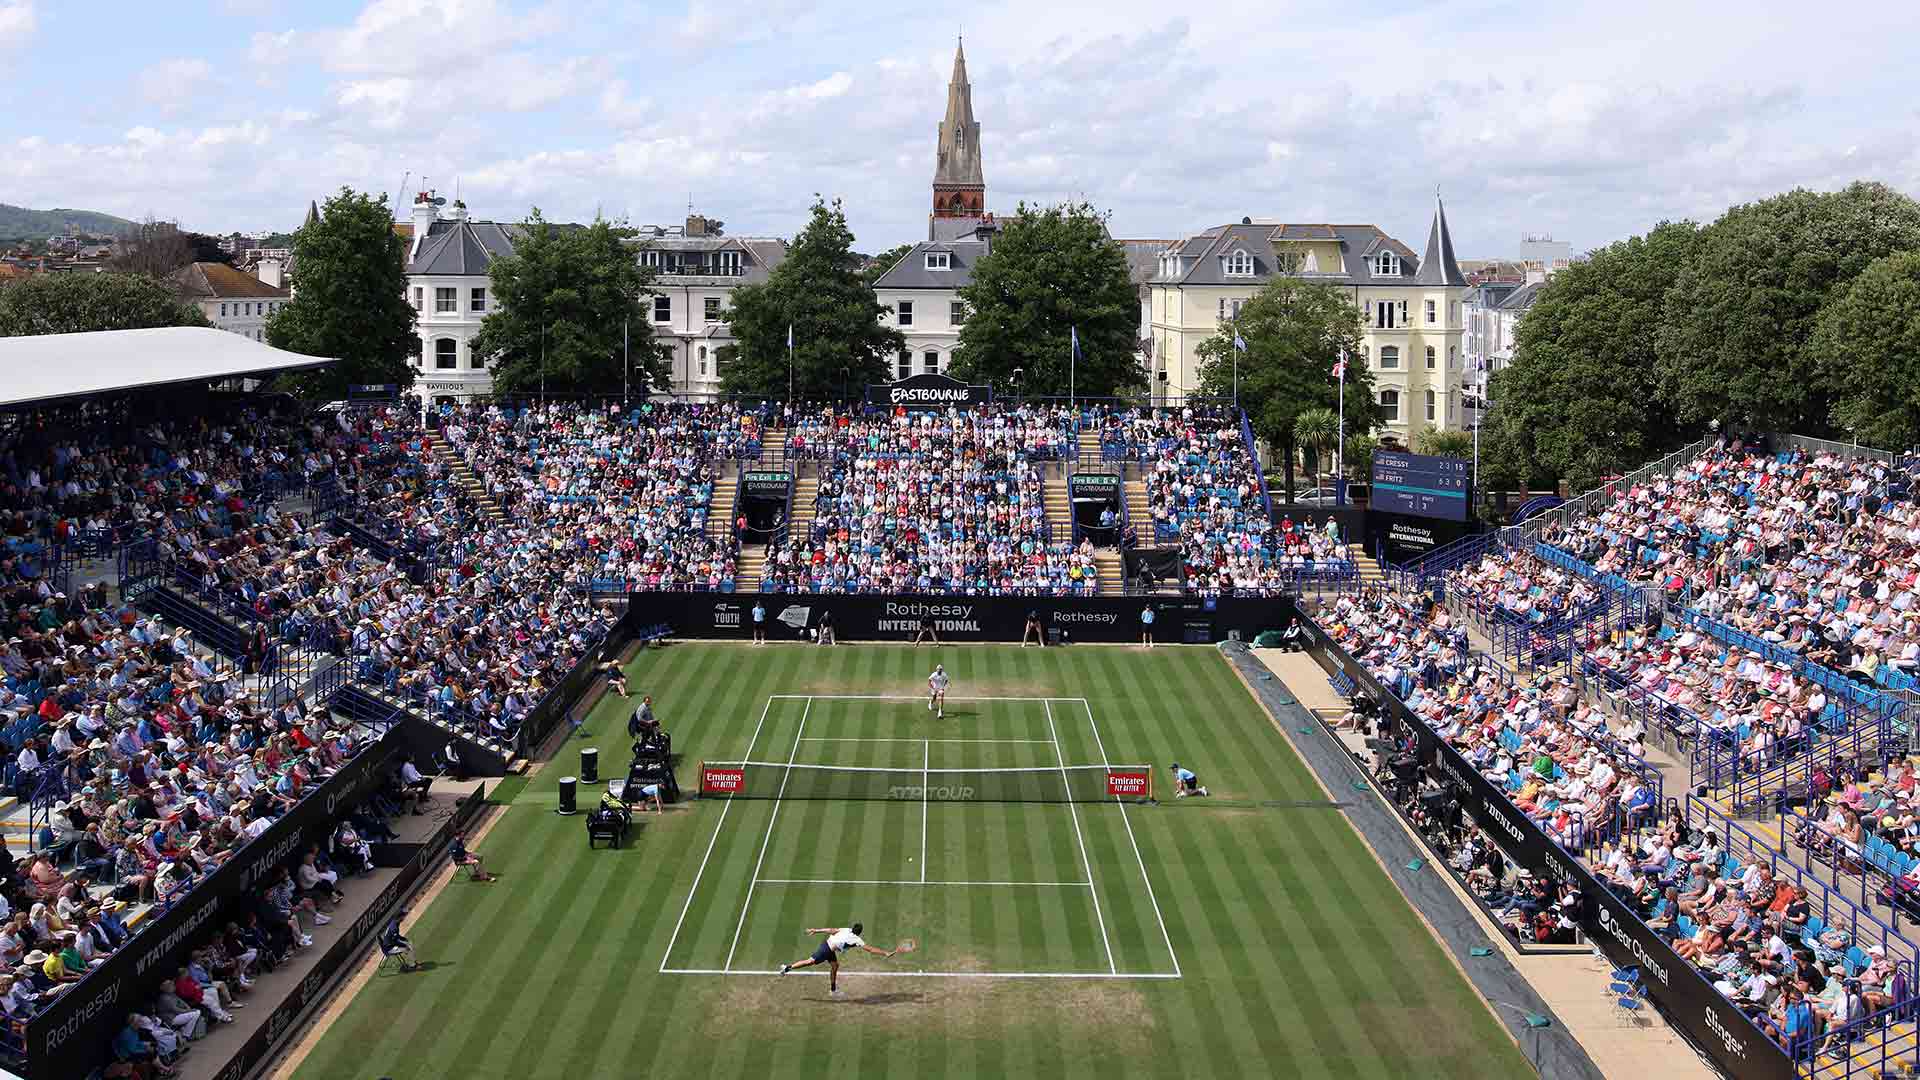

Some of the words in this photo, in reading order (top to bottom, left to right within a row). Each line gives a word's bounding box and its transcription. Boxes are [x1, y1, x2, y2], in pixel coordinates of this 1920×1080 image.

[890, 388, 969, 402] EASTBOURNE
[1385, 460, 1409, 468] CRESSY
[1455, 463, 1464, 471] 15
[1385, 475, 1403, 483] FRITZ
[1456, 479, 1461, 487] 0
[1392, 523, 1431, 537] Rothesay
[1389, 532, 1435, 544] INTERNATIONAL
[886, 602, 973, 619] Rothesay
[714, 612, 740, 624] YOUTH
[1053, 612, 1118, 625] Rothesay
[706, 772, 742, 781] Emirates
[1109, 776, 1145, 785] Emirates
[888, 785, 923, 800] ATP
[927, 786, 975, 800] TOUR
[1488, 803, 1525, 843] DUNLOP
[136, 895, 218, 977] WTATENNIS.COM
[1610, 917, 1632, 950] Clear
[1632, 939, 1669, 987] Channel
[46, 977, 121, 1056] Rothesay
